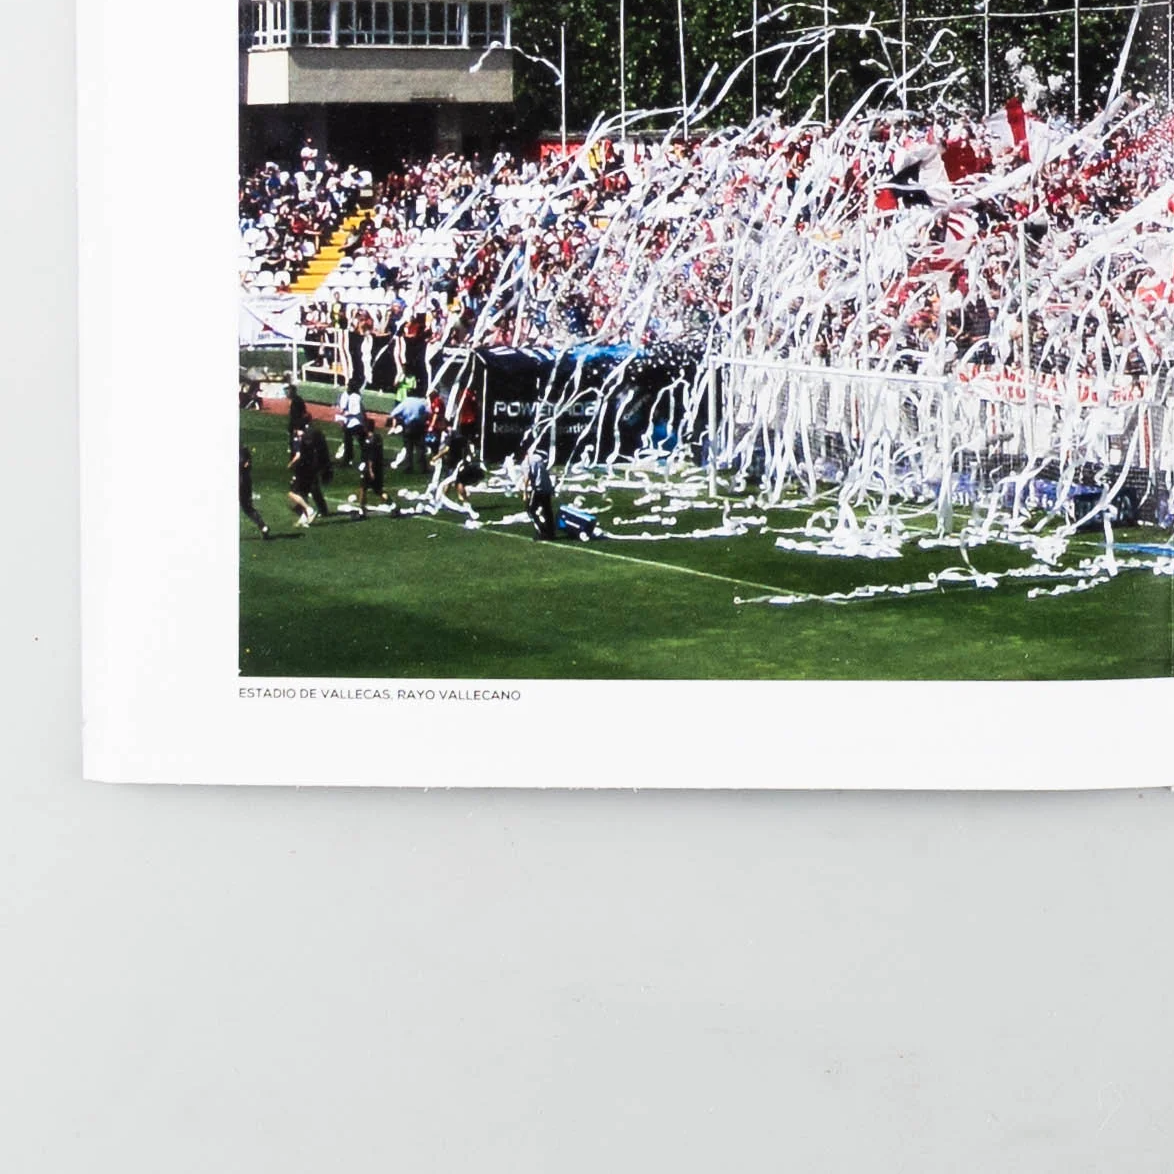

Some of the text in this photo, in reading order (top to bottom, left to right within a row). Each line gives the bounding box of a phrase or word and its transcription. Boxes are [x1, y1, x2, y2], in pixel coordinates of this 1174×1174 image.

[238, 687, 296, 698] ESTADIO
[299, 688, 316, 698] DE
[397, 689, 435, 700] RAYO
[438, 689, 522, 701] VALLECANO
